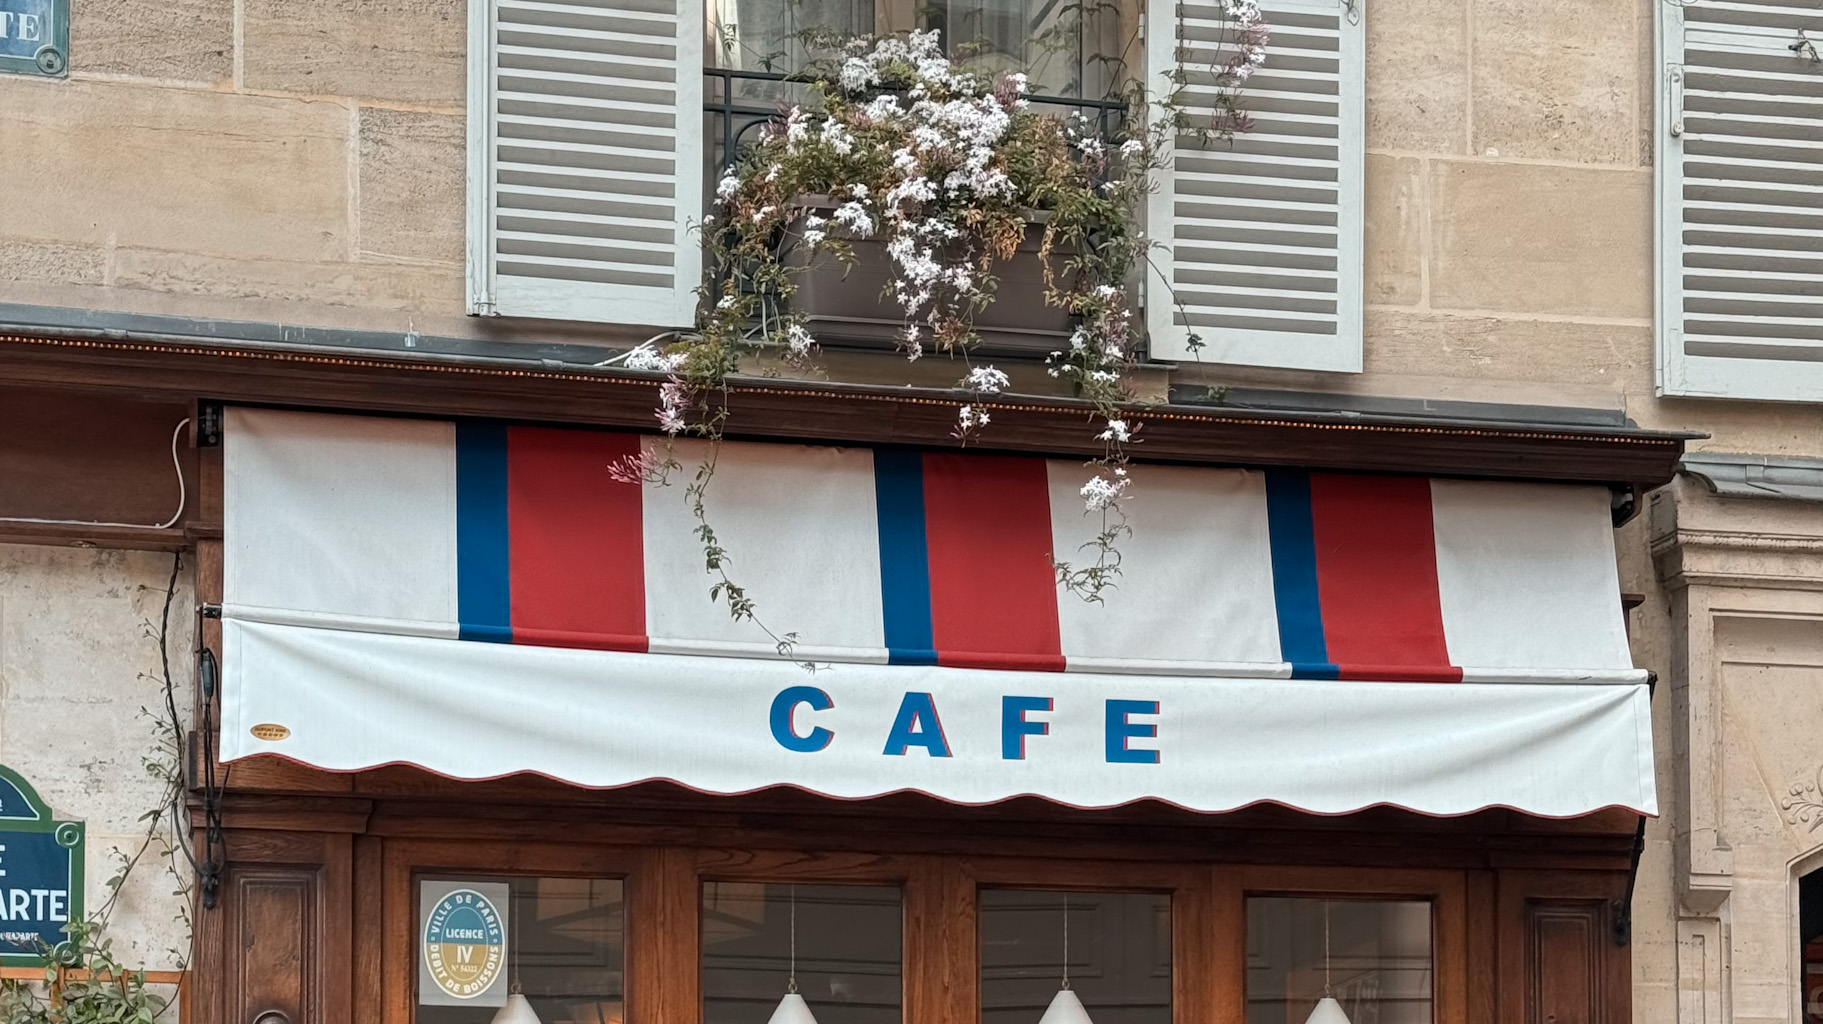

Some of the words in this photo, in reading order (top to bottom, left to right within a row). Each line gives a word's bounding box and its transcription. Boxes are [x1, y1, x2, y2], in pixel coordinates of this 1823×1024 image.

[769, 685, 1161, 765] CAFE
[431, 901, 453, 934] VILLE
[455, 894, 473, 904] DE
[476, 900, 499, 936] PARIS
[445, 928, 484, 939] LICENCE
[445, 979, 461, 993] DE
[463, 946, 499, 994] BOISSONS
[456, 945, 473, 964] IV
